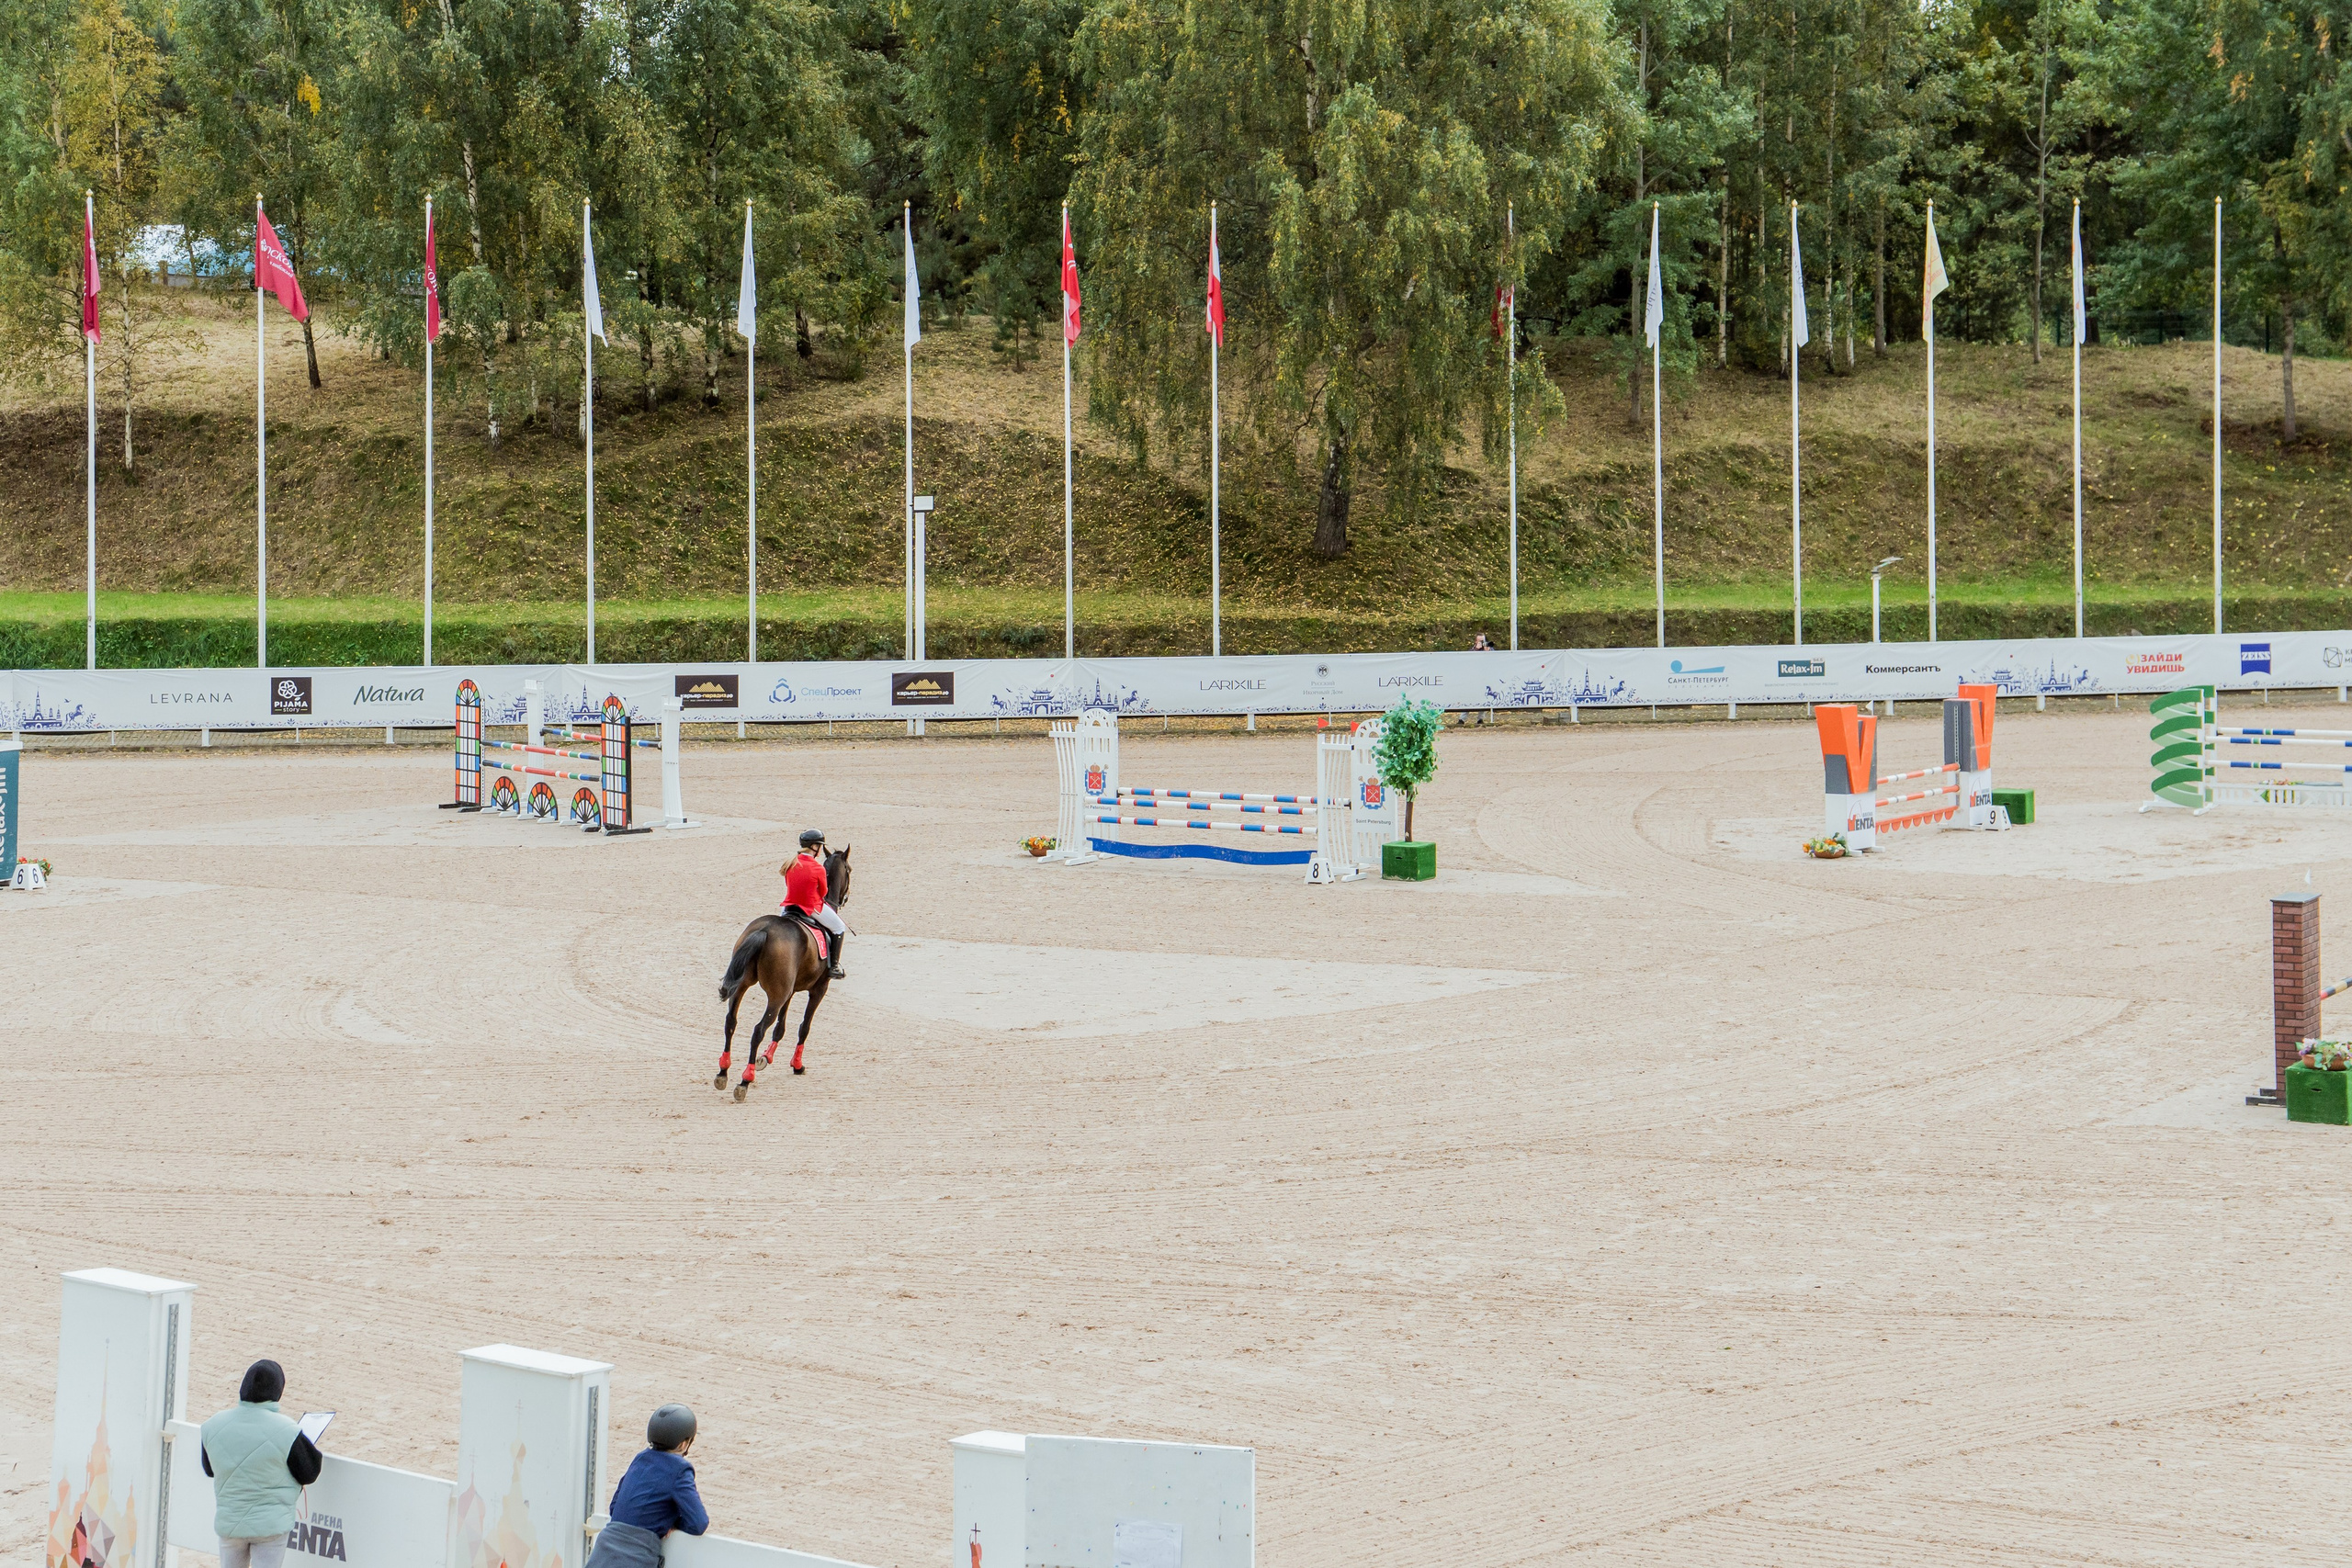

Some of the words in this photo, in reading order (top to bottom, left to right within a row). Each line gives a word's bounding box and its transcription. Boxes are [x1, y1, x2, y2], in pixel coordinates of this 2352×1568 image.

[2141, 651, 2182, 662] ЗАЙДИ
[2241, 650, 2271, 660] ZEISS
[1865, 664, 1941, 674] Коммерсантъ
[2126, 664, 2185, 674] УВИДИШЬ
[150, 693, 233, 704] LEVRANA
[353, 685, 424, 705] Natura
[800, 687, 862, 697] СпецПроект
[1990, 810, 1996, 825] 9
[17, 868, 24, 885] 6
[32, 867, 40, 884] 6
[1312, 863, 1319, 879] 8
[311, 1511, 344, 1530] АРЕНА
